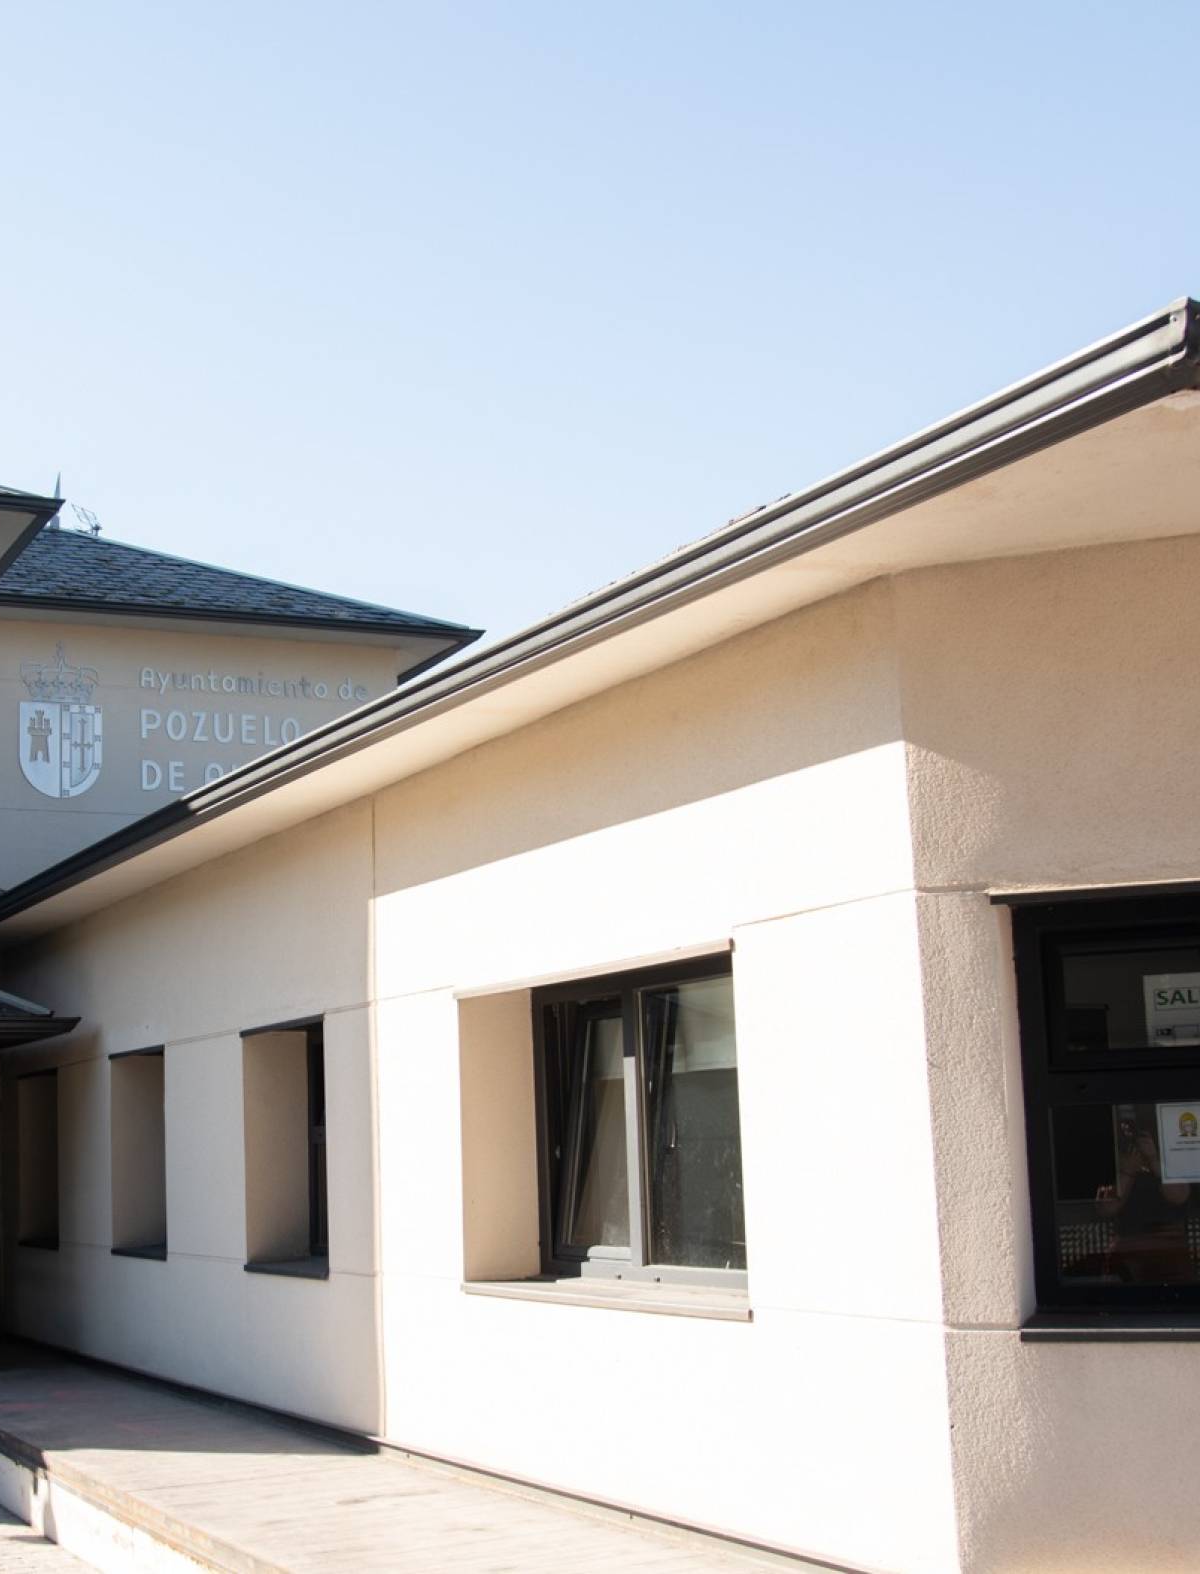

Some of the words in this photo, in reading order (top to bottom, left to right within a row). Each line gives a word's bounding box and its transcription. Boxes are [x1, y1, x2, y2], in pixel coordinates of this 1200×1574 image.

[139, 667, 328, 699] Ayuntamiento
[339, 677, 369, 701] de
[140, 709, 300, 746] POZUELO
[142, 760, 186, 791] DE
